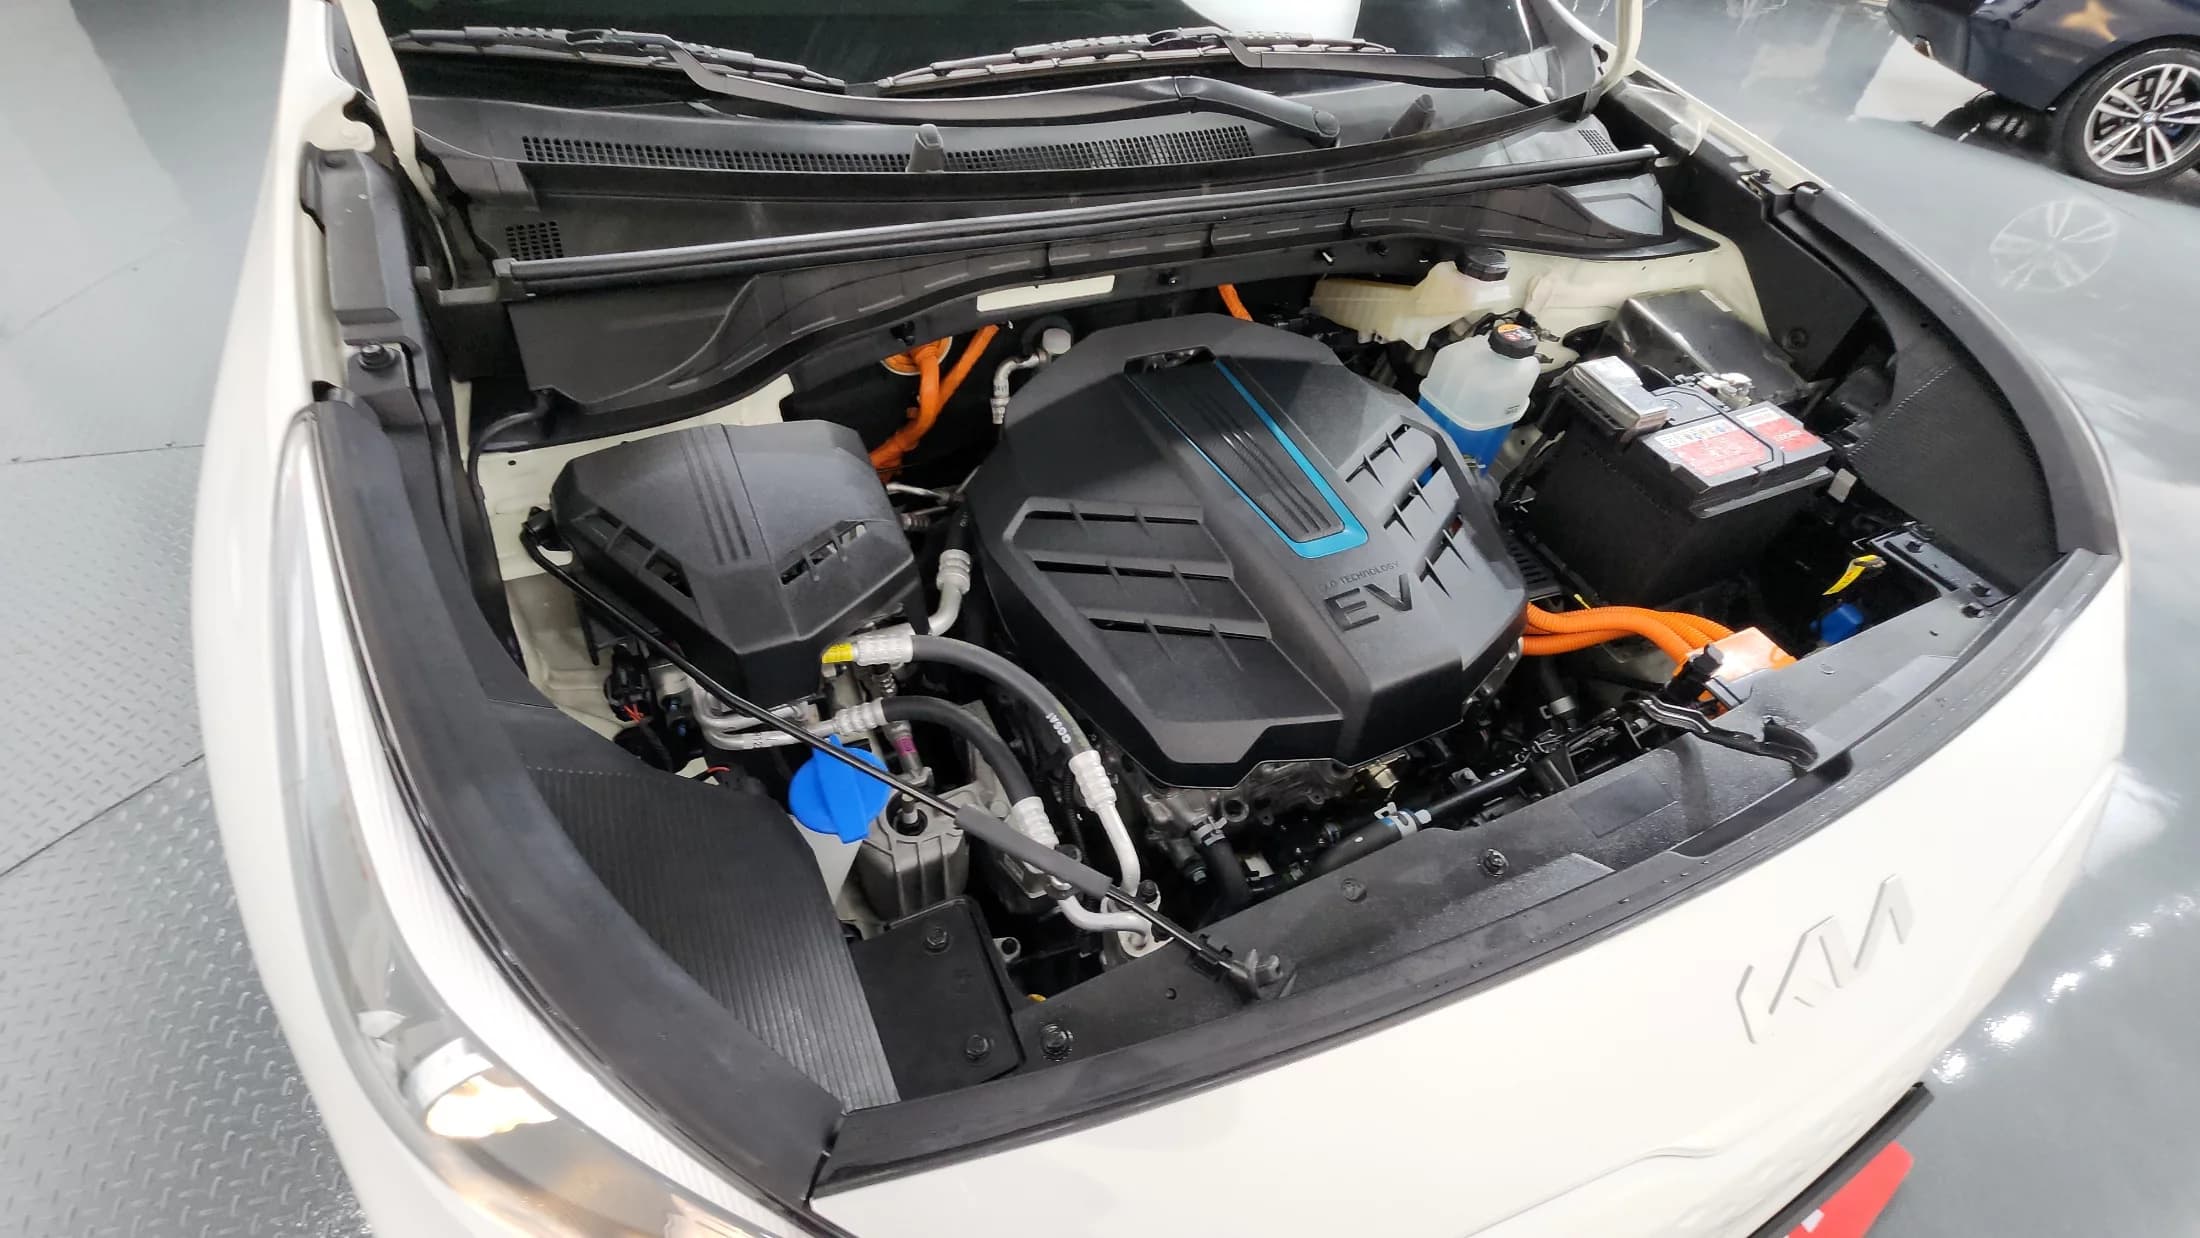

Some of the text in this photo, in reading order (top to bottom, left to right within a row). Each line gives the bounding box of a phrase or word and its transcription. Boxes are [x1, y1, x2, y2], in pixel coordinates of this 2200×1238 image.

[1340, 560, 1399, 584] TECHNOLOGY
[1323, 573, 1412, 632] EV
[1736, 873, 1915, 1044] KIA
